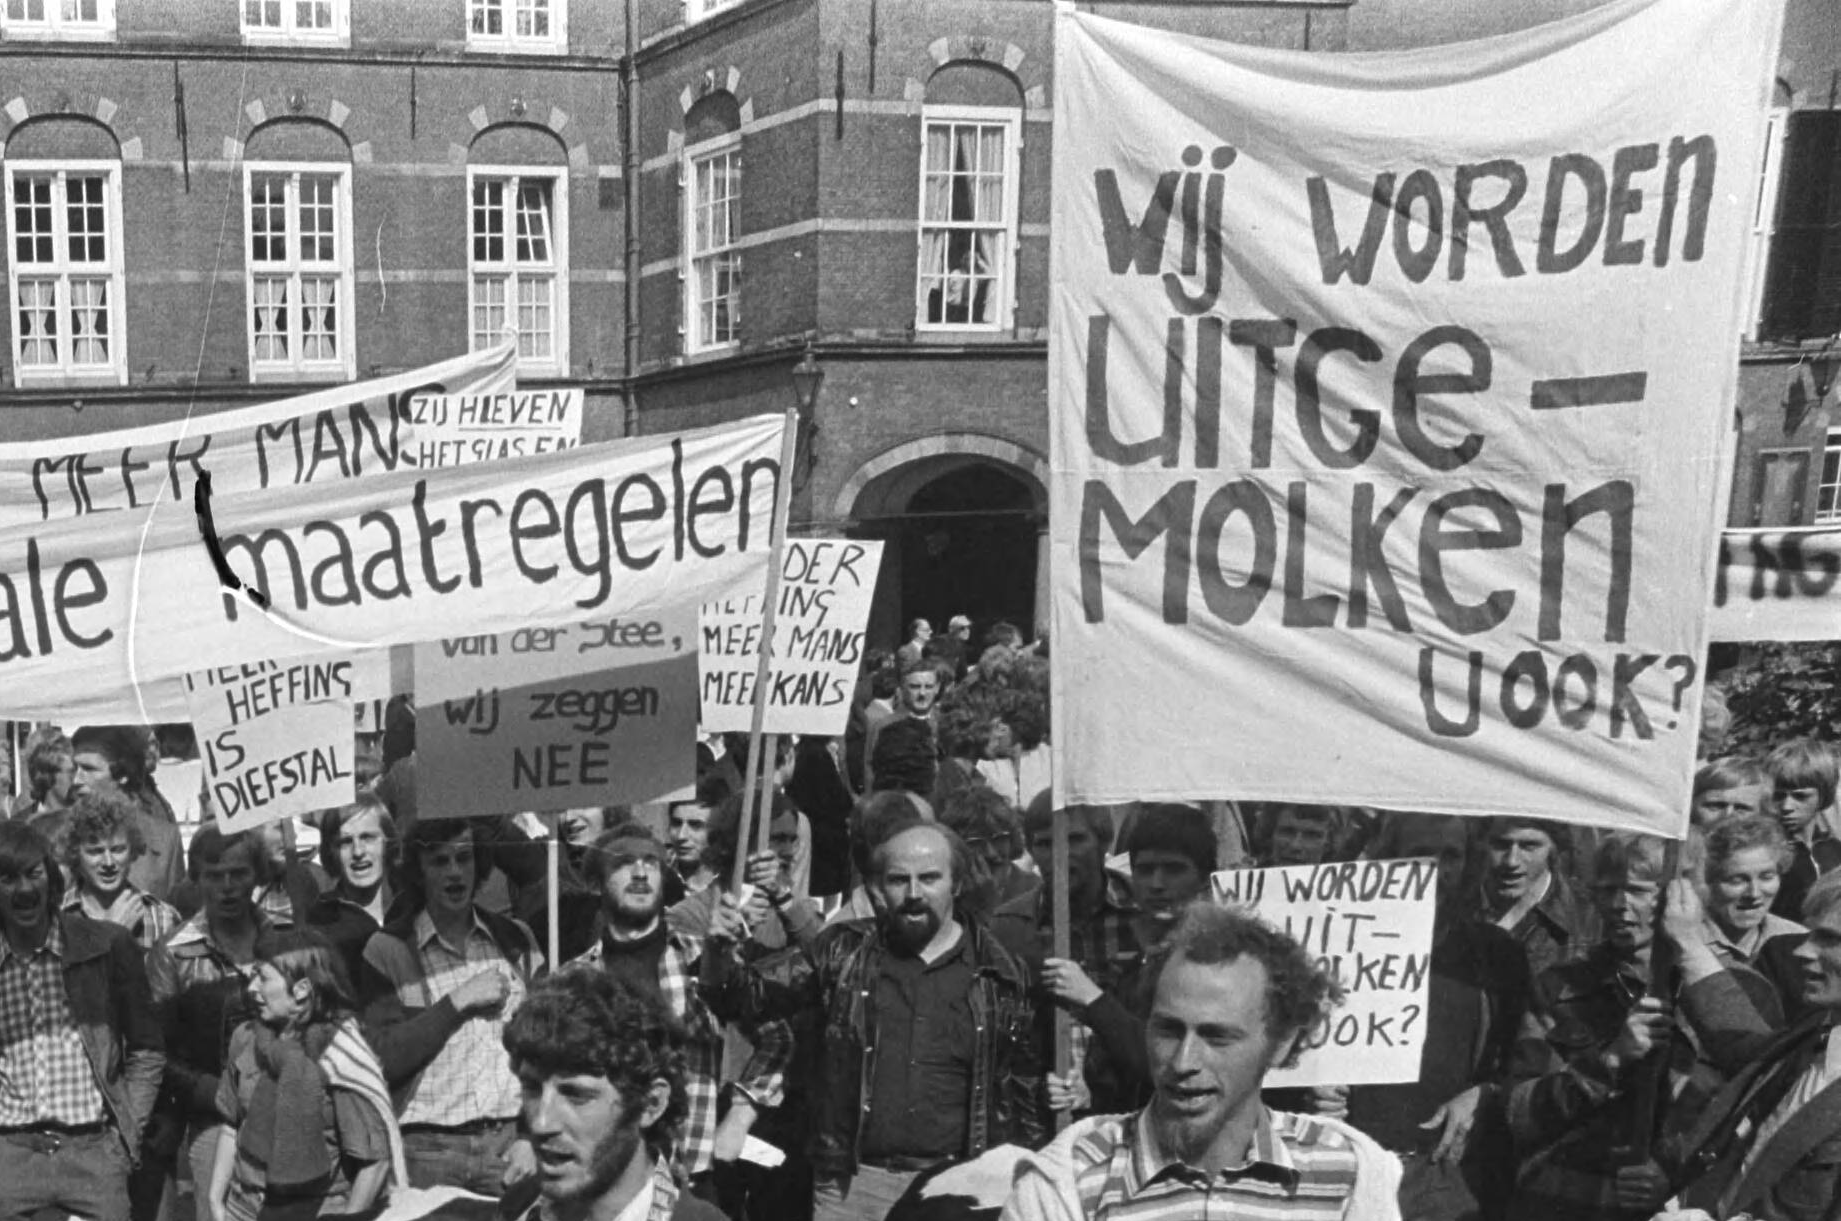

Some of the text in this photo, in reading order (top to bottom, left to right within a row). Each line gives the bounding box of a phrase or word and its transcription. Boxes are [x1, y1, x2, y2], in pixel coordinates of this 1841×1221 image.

[412, 396, 449, 427] ZIJ
[219, 437, 781, 622] maatregelen
[787, 625, 866, 664] MANS
[529, 685, 658, 736] zeggen
[770, 670, 849, 707] KANS
[205, 730, 246, 778] IS
[512, 741, 611, 790] NEE
[214, 745, 352, 818] DIEFSTAL
[1212, 860, 1437, 911] WIJ WORDEN
